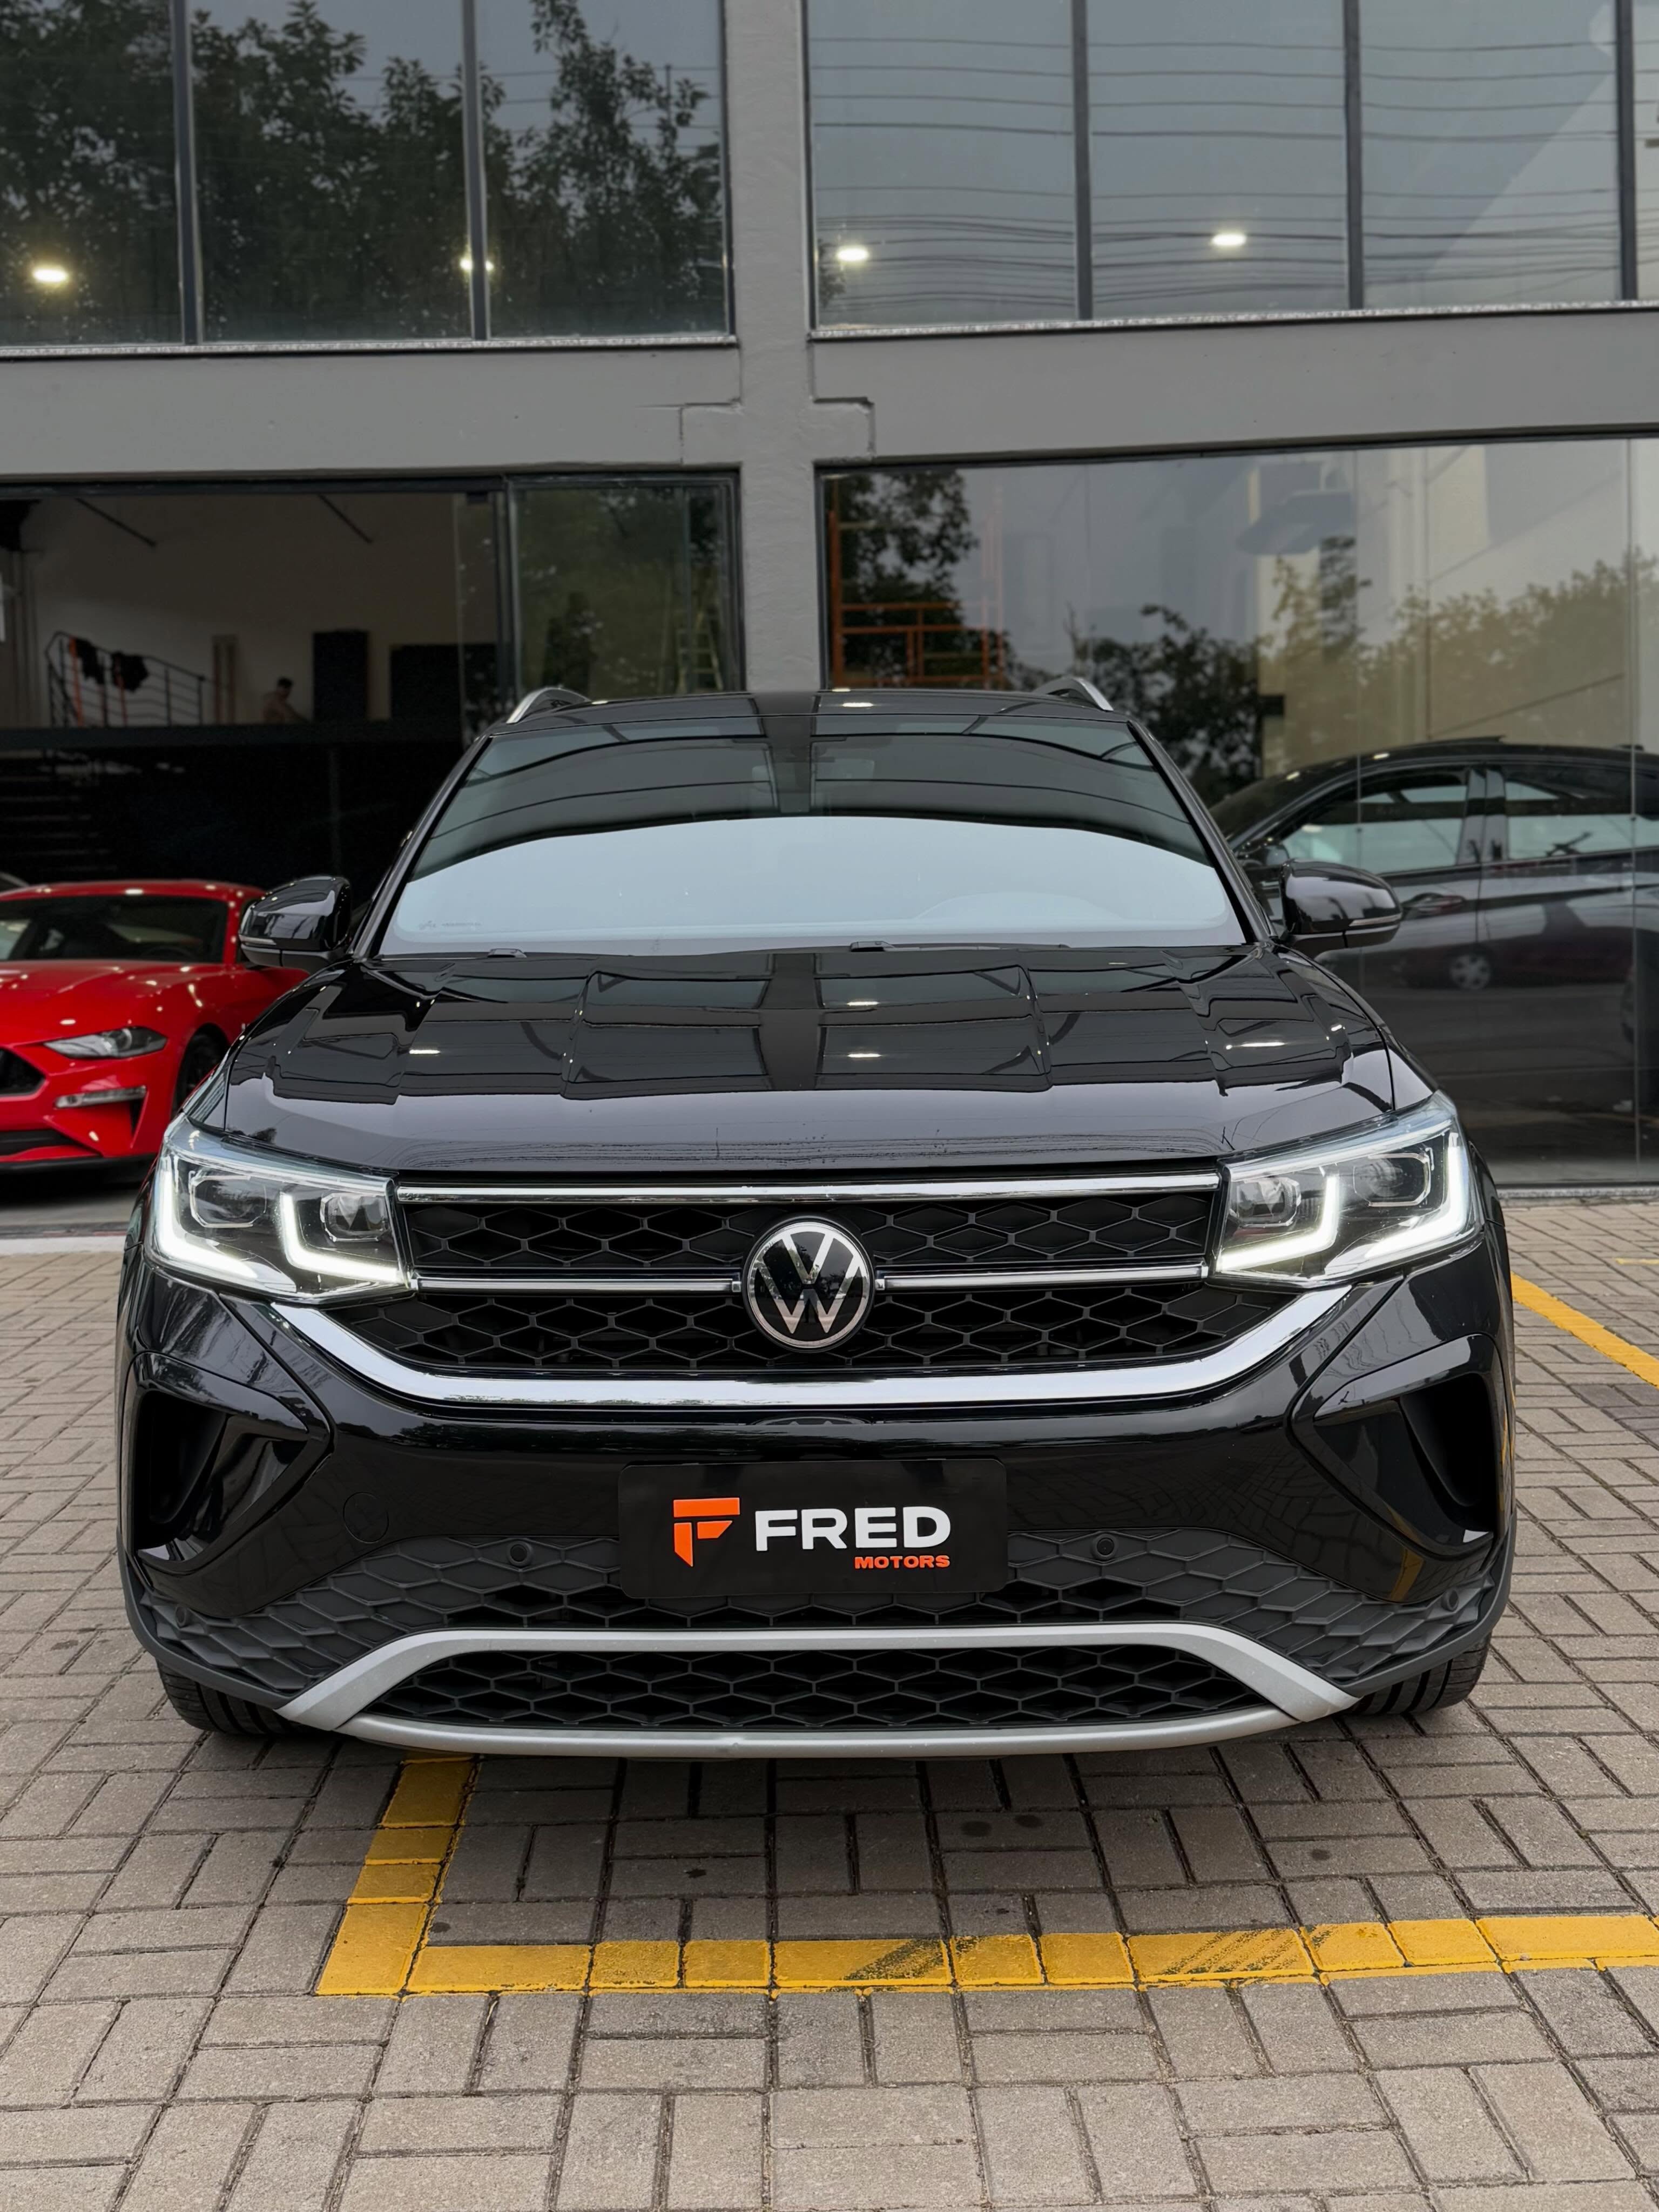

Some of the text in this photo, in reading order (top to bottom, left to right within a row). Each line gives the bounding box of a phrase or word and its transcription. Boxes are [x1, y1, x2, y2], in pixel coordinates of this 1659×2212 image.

[754, 1226, 866, 1336] VW
[755, 1506, 951, 1552] FRED
[854, 1555, 950, 1569] MOTORS
